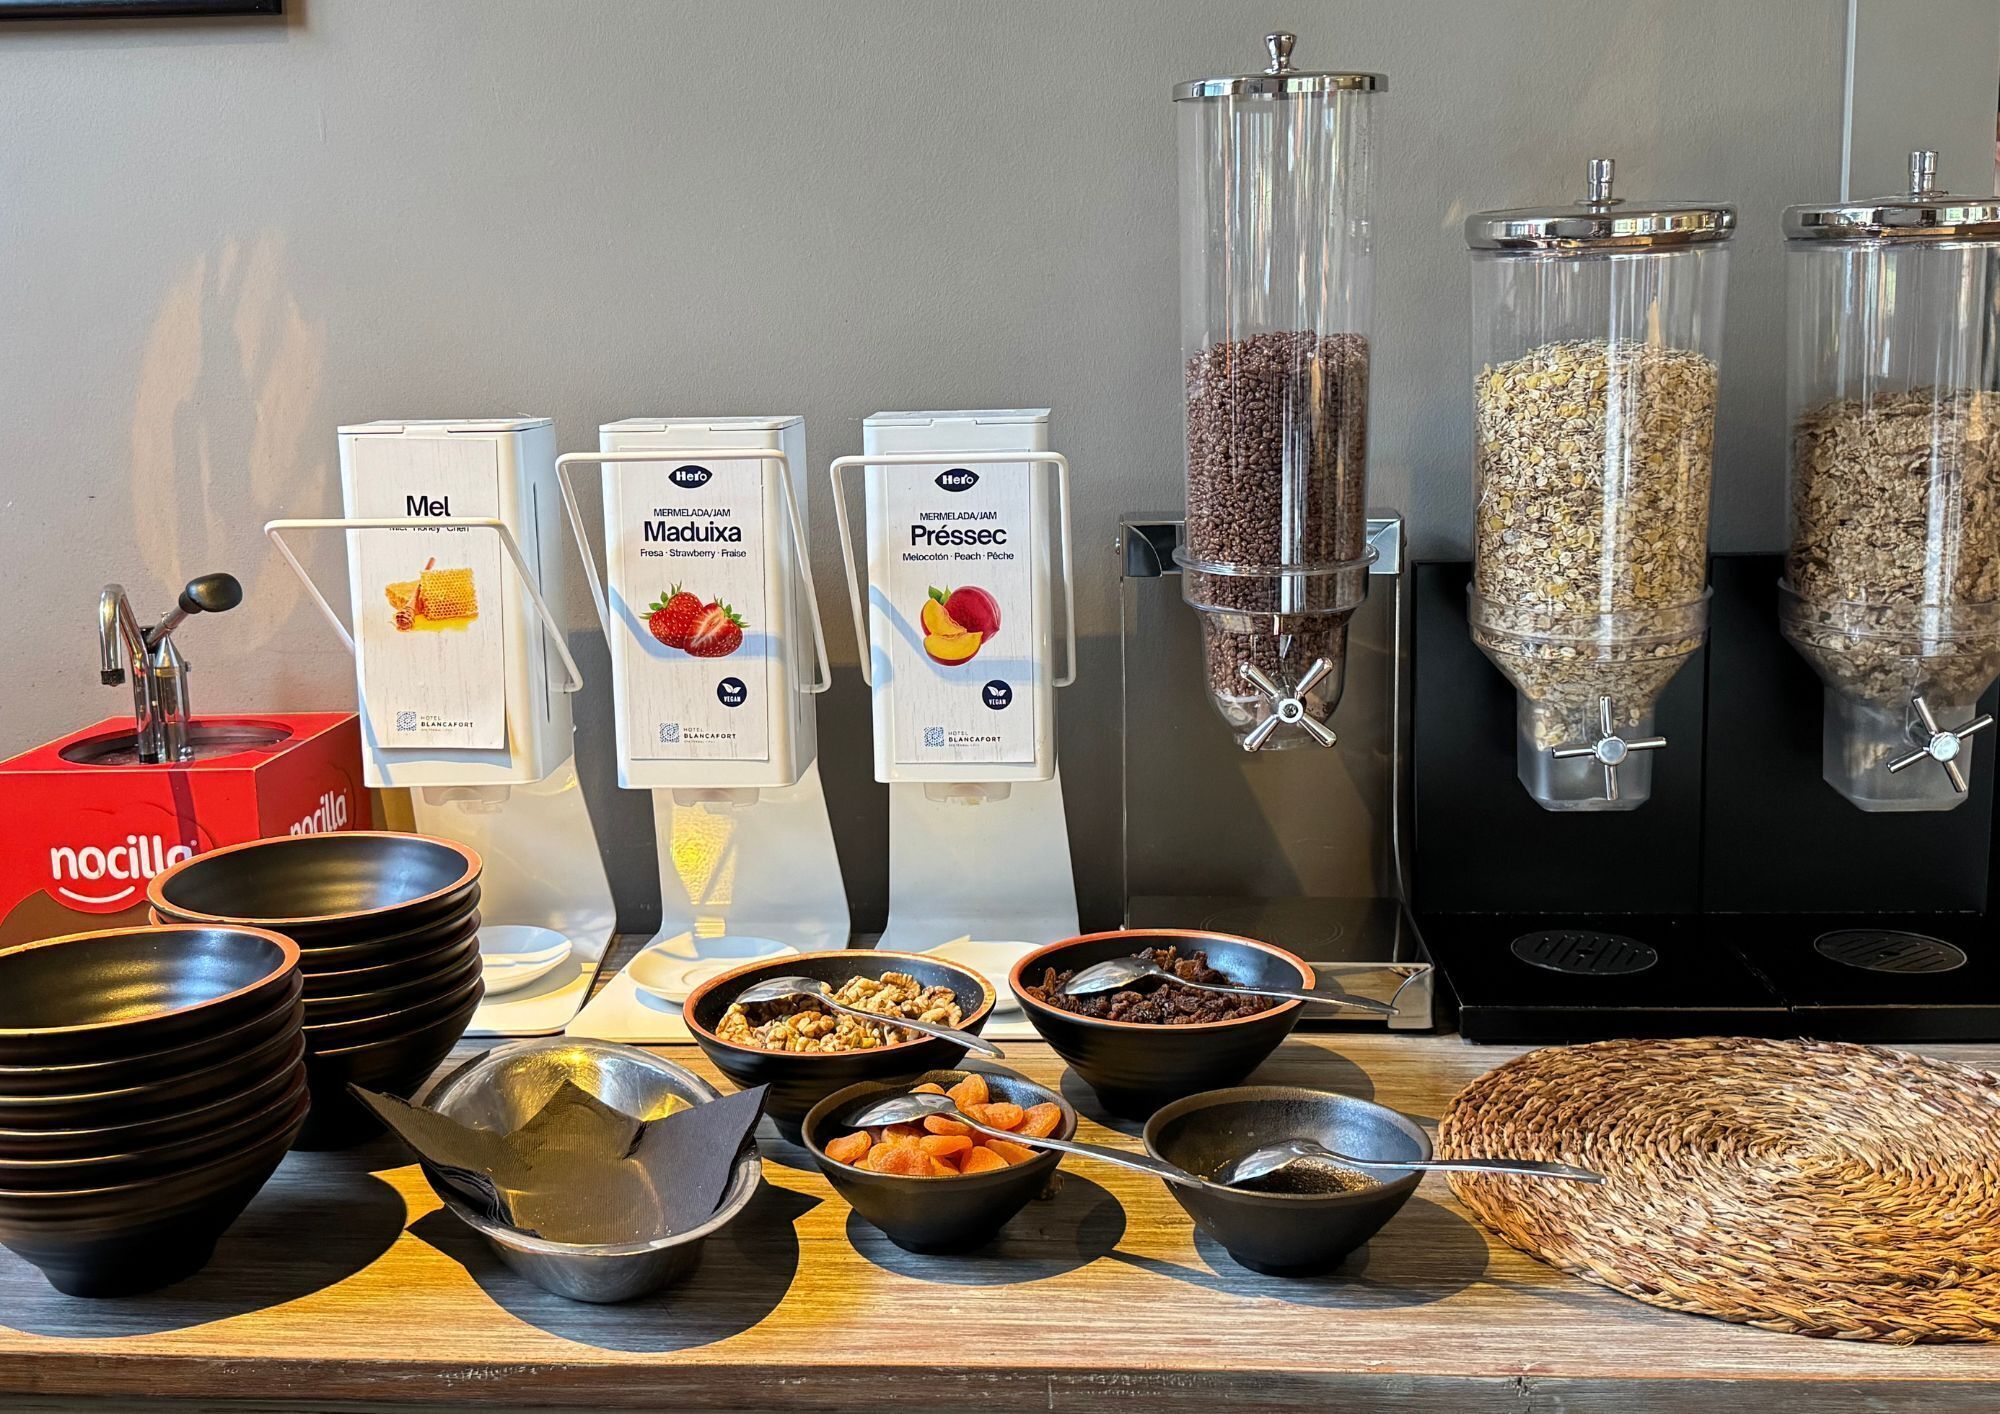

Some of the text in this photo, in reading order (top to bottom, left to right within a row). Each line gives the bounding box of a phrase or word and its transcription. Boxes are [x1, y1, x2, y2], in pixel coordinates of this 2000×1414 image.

[675, 471, 708, 482] Hero
[942, 474, 974, 485] Hero
[406, 495, 451, 517] Mel
[653, 508, 731, 518] MERMELADA/JAM
[919, 511, 997, 521] MERMELADA/JAM
[644, 521, 741, 542] Maduixa
[911, 524, 1007, 546] Préssec
[640, 549, 747, 559] Fresa Strawberry Fraise
[902, 552, 949, 561] Melocotón
[954, 552, 982, 561] Peach
